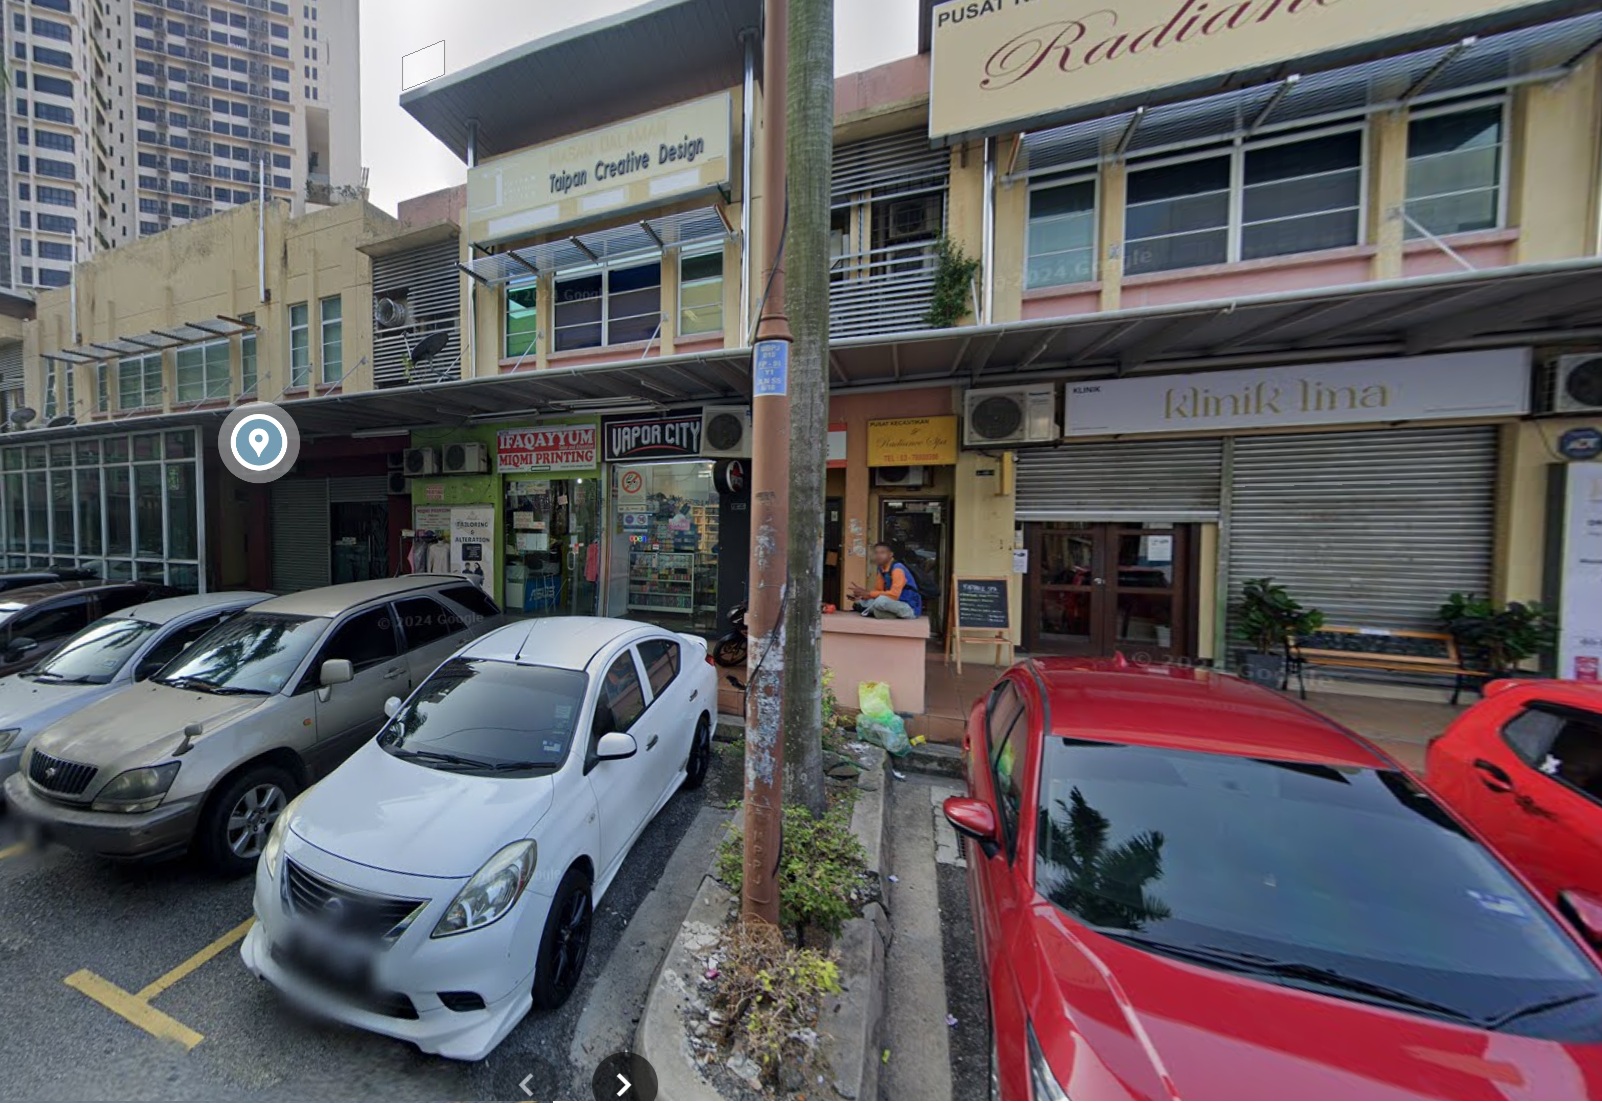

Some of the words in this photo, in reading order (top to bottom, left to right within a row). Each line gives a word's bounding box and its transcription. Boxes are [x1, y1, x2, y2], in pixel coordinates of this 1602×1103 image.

[979, 0, 1338, 90] Radian
[549, 169, 588, 195] Taipan
[594, 150, 650, 182] Creative
[658, 134, 704, 165] Design
[1073, 386, 1101, 394] KLINIK
[1164, 380, 1281, 419] klinik
[612, 424, 661, 457] VAPOR
[665, 420, 700, 453] CITY
[499, 454, 533, 467] MIQMI
[536, 450, 594, 464] PRINTING
